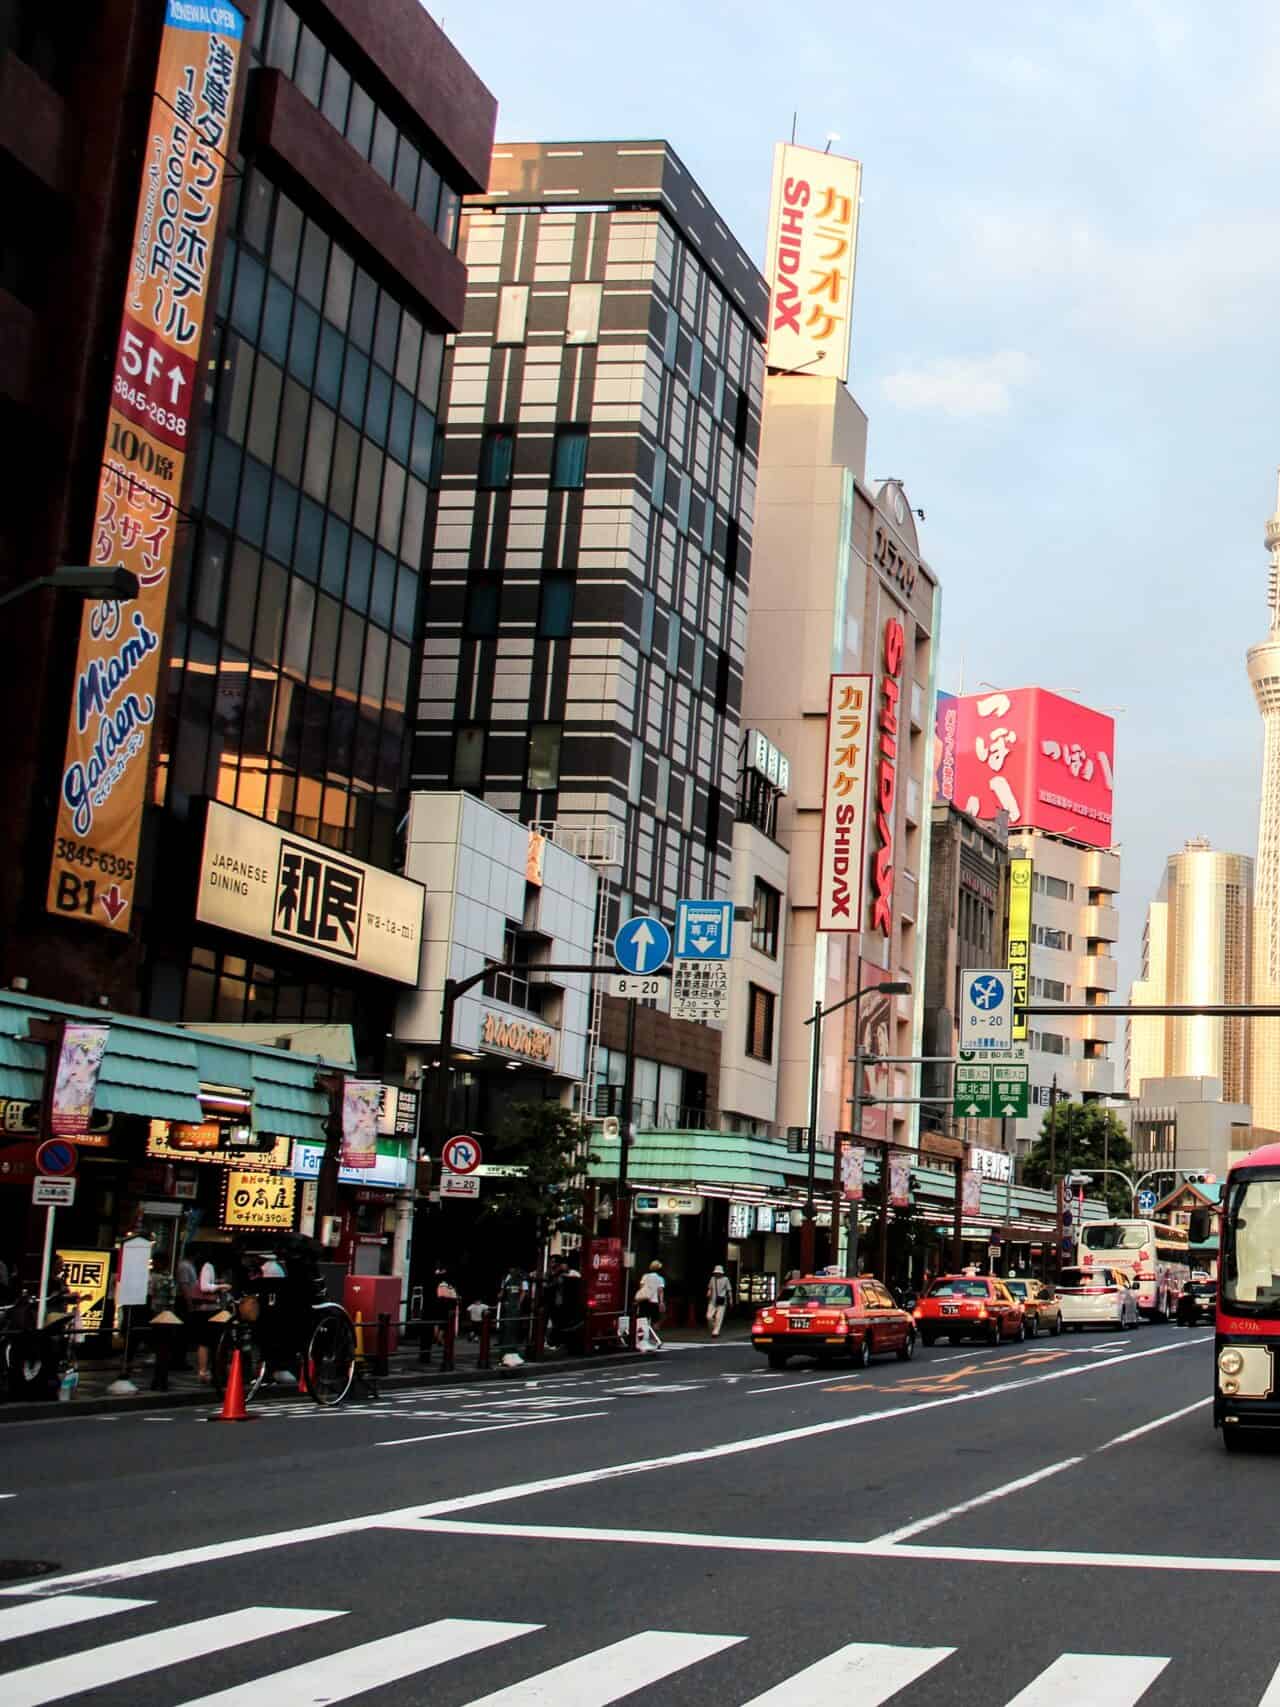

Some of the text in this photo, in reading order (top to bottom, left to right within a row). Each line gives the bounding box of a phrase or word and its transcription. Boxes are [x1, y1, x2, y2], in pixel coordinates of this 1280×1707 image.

[806, 187, 852, 341] カラオケ
[122, 329, 163, 386] 5F
[114, 375, 187, 436] 3845-2638
[138, 486, 173, 587] ワイン
[77, 612, 156, 732] Miami
[832, 684, 864, 799] カラオケ
[55, 838, 134, 878] 3845-6395
[209, 870, 250, 896] DINING
[212, 853, 269, 885] JAPANESE
[56, 871, 97, 916] B1
[277, 852, 361, 950] 和民
